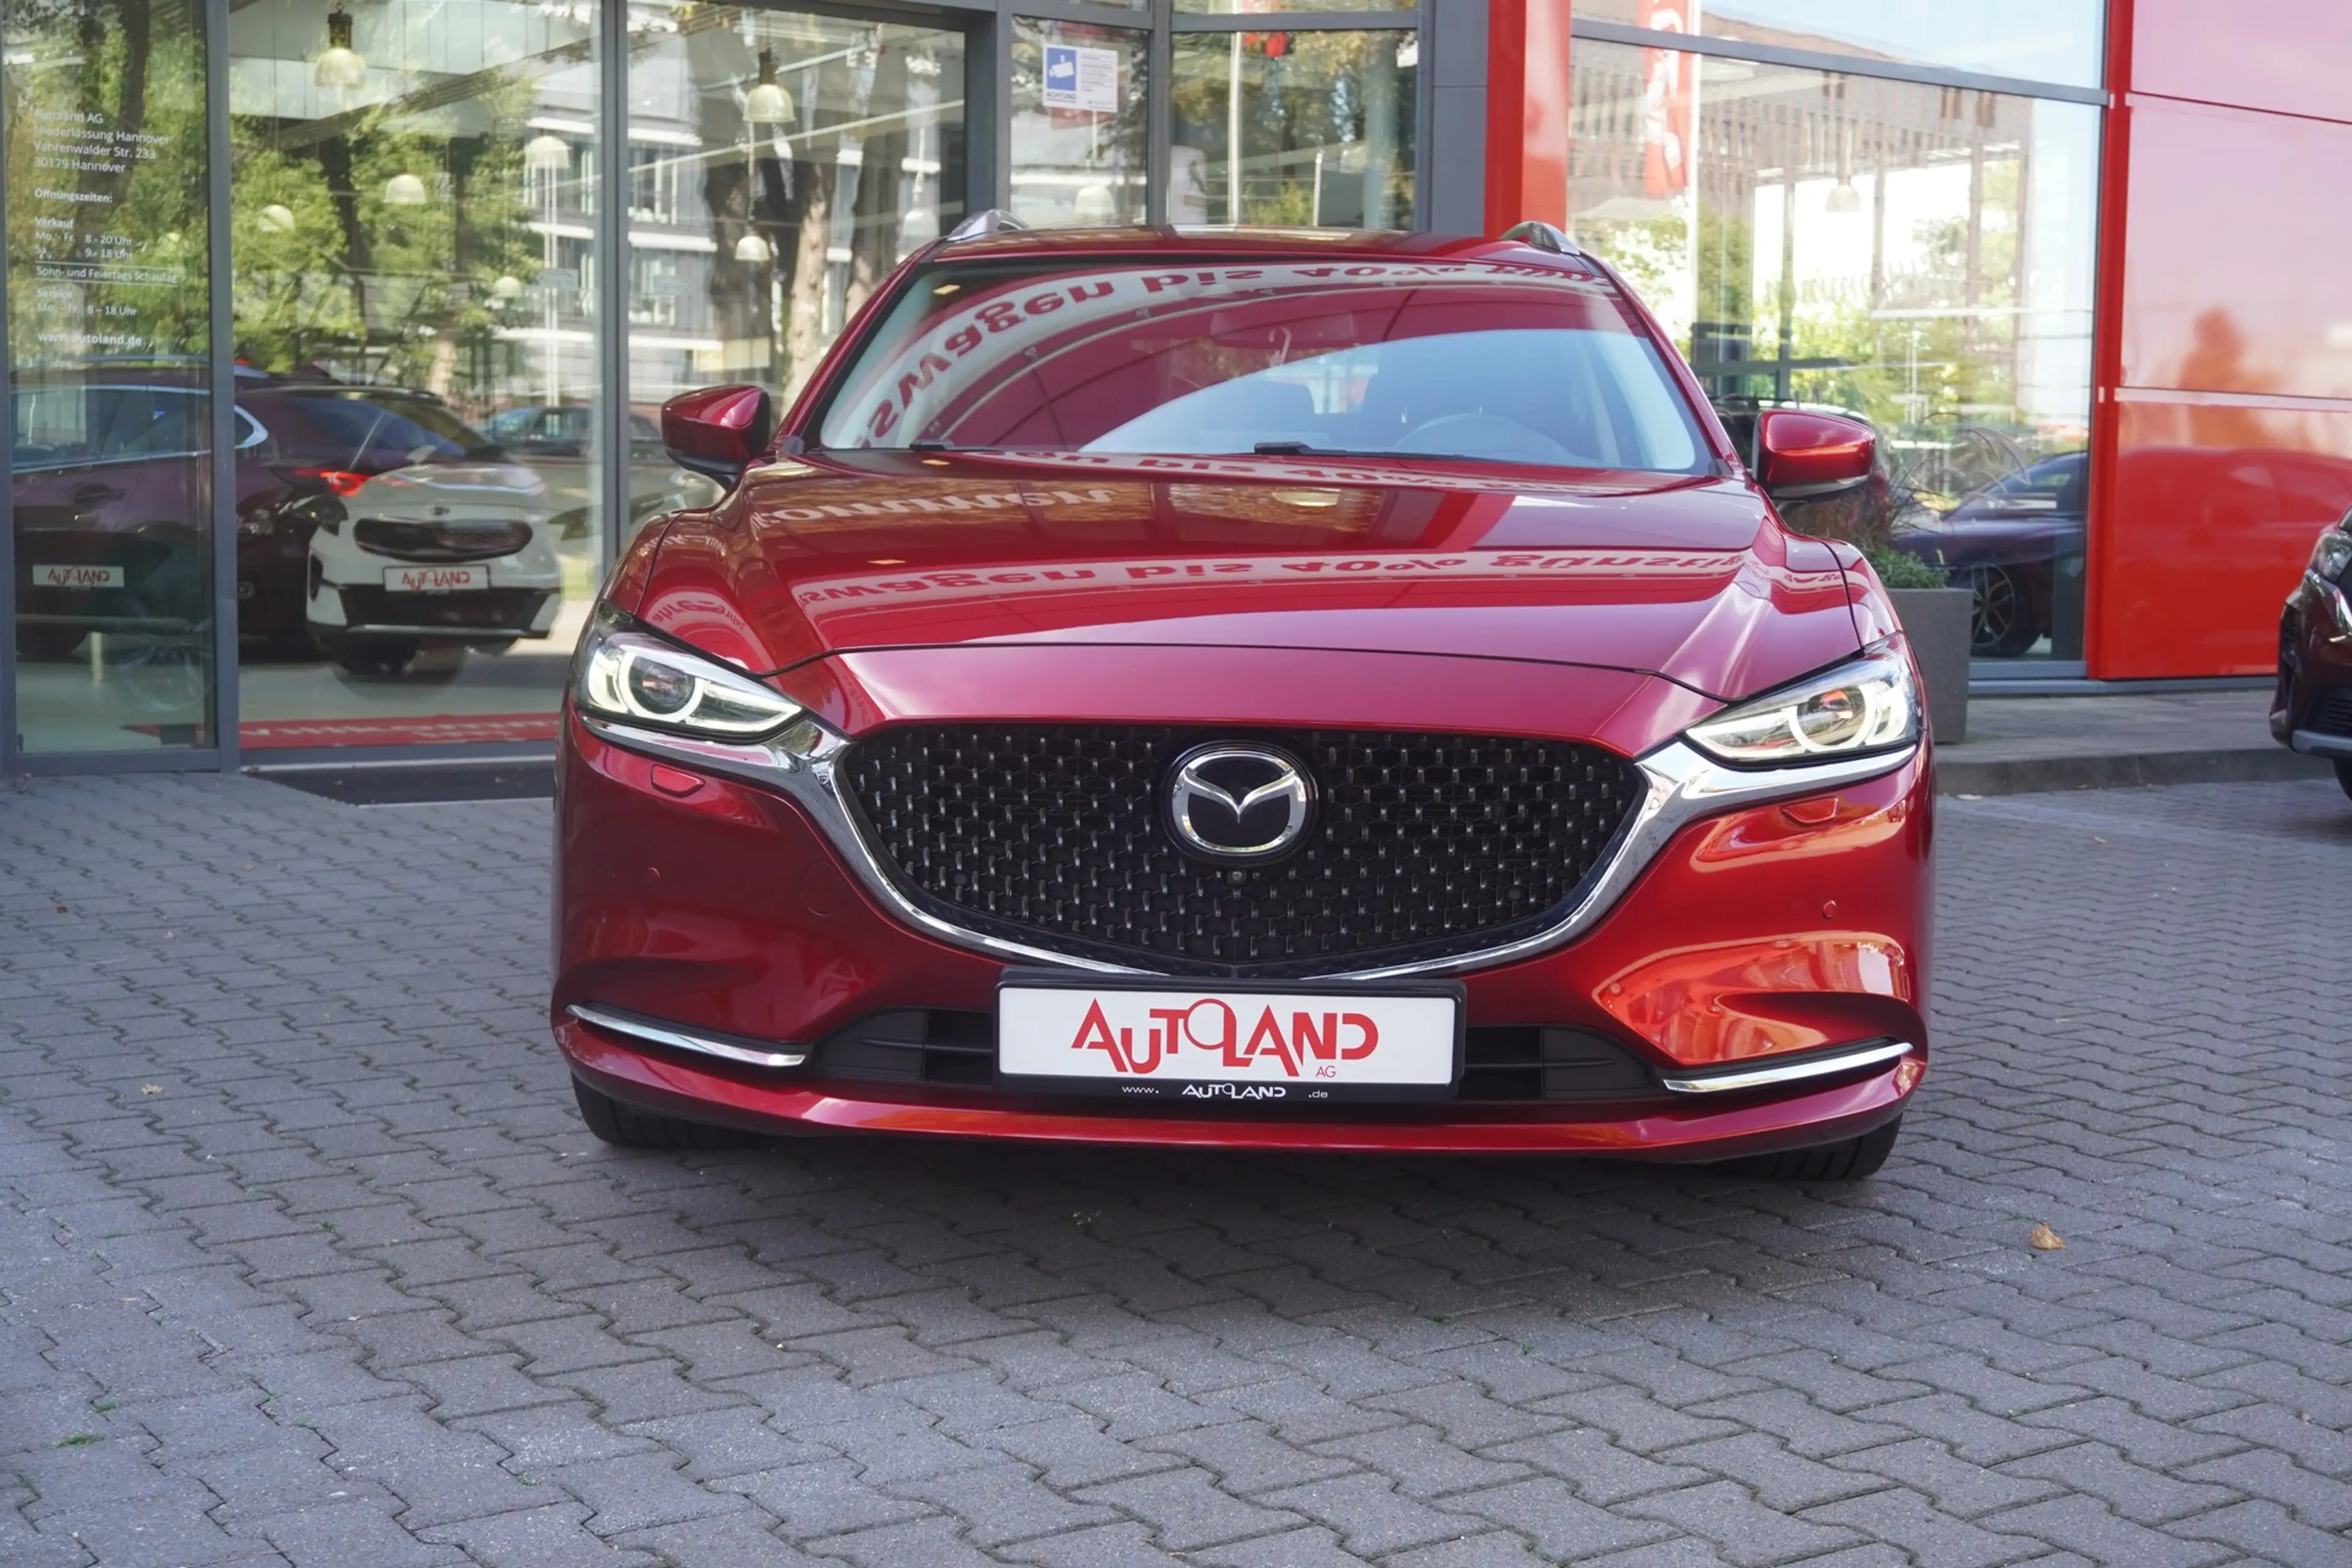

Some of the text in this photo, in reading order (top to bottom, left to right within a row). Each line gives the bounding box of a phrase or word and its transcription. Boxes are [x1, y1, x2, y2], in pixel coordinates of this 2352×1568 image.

[34, 110, 104, 124] Autoland AG
[34, 126, 169, 145] Niederlassung Hannover
[114, 146, 133, 157] Str.
[34, 157, 126, 173] 30179 Hannover
[36, 217, 74, 228] Verkauf
[85, 234, 91, 244] 8
[100, 235, 113, 244] 20
[115, 235, 132, 245] Uhr
[101, 248, 112, 258] 18
[115, 249, 132, 258] Uhr
[67, 268, 86, 277] und
[87, 305, 94, 314] 8
[105, 306, 117, 315] 18
[119, 306, 137, 316] Uhr
[37, 333, 142, 345] wwwutoland.de
[402, 570, 470, 592] AUTOLAND
[1071, 998, 1379, 1077] AUTOLAND
[1315, 1065, 1336, 1078] AG
[1181, 1082, 1287, 1100] AUTOLAND
[1308, 1090, 1329, 1099] .de
